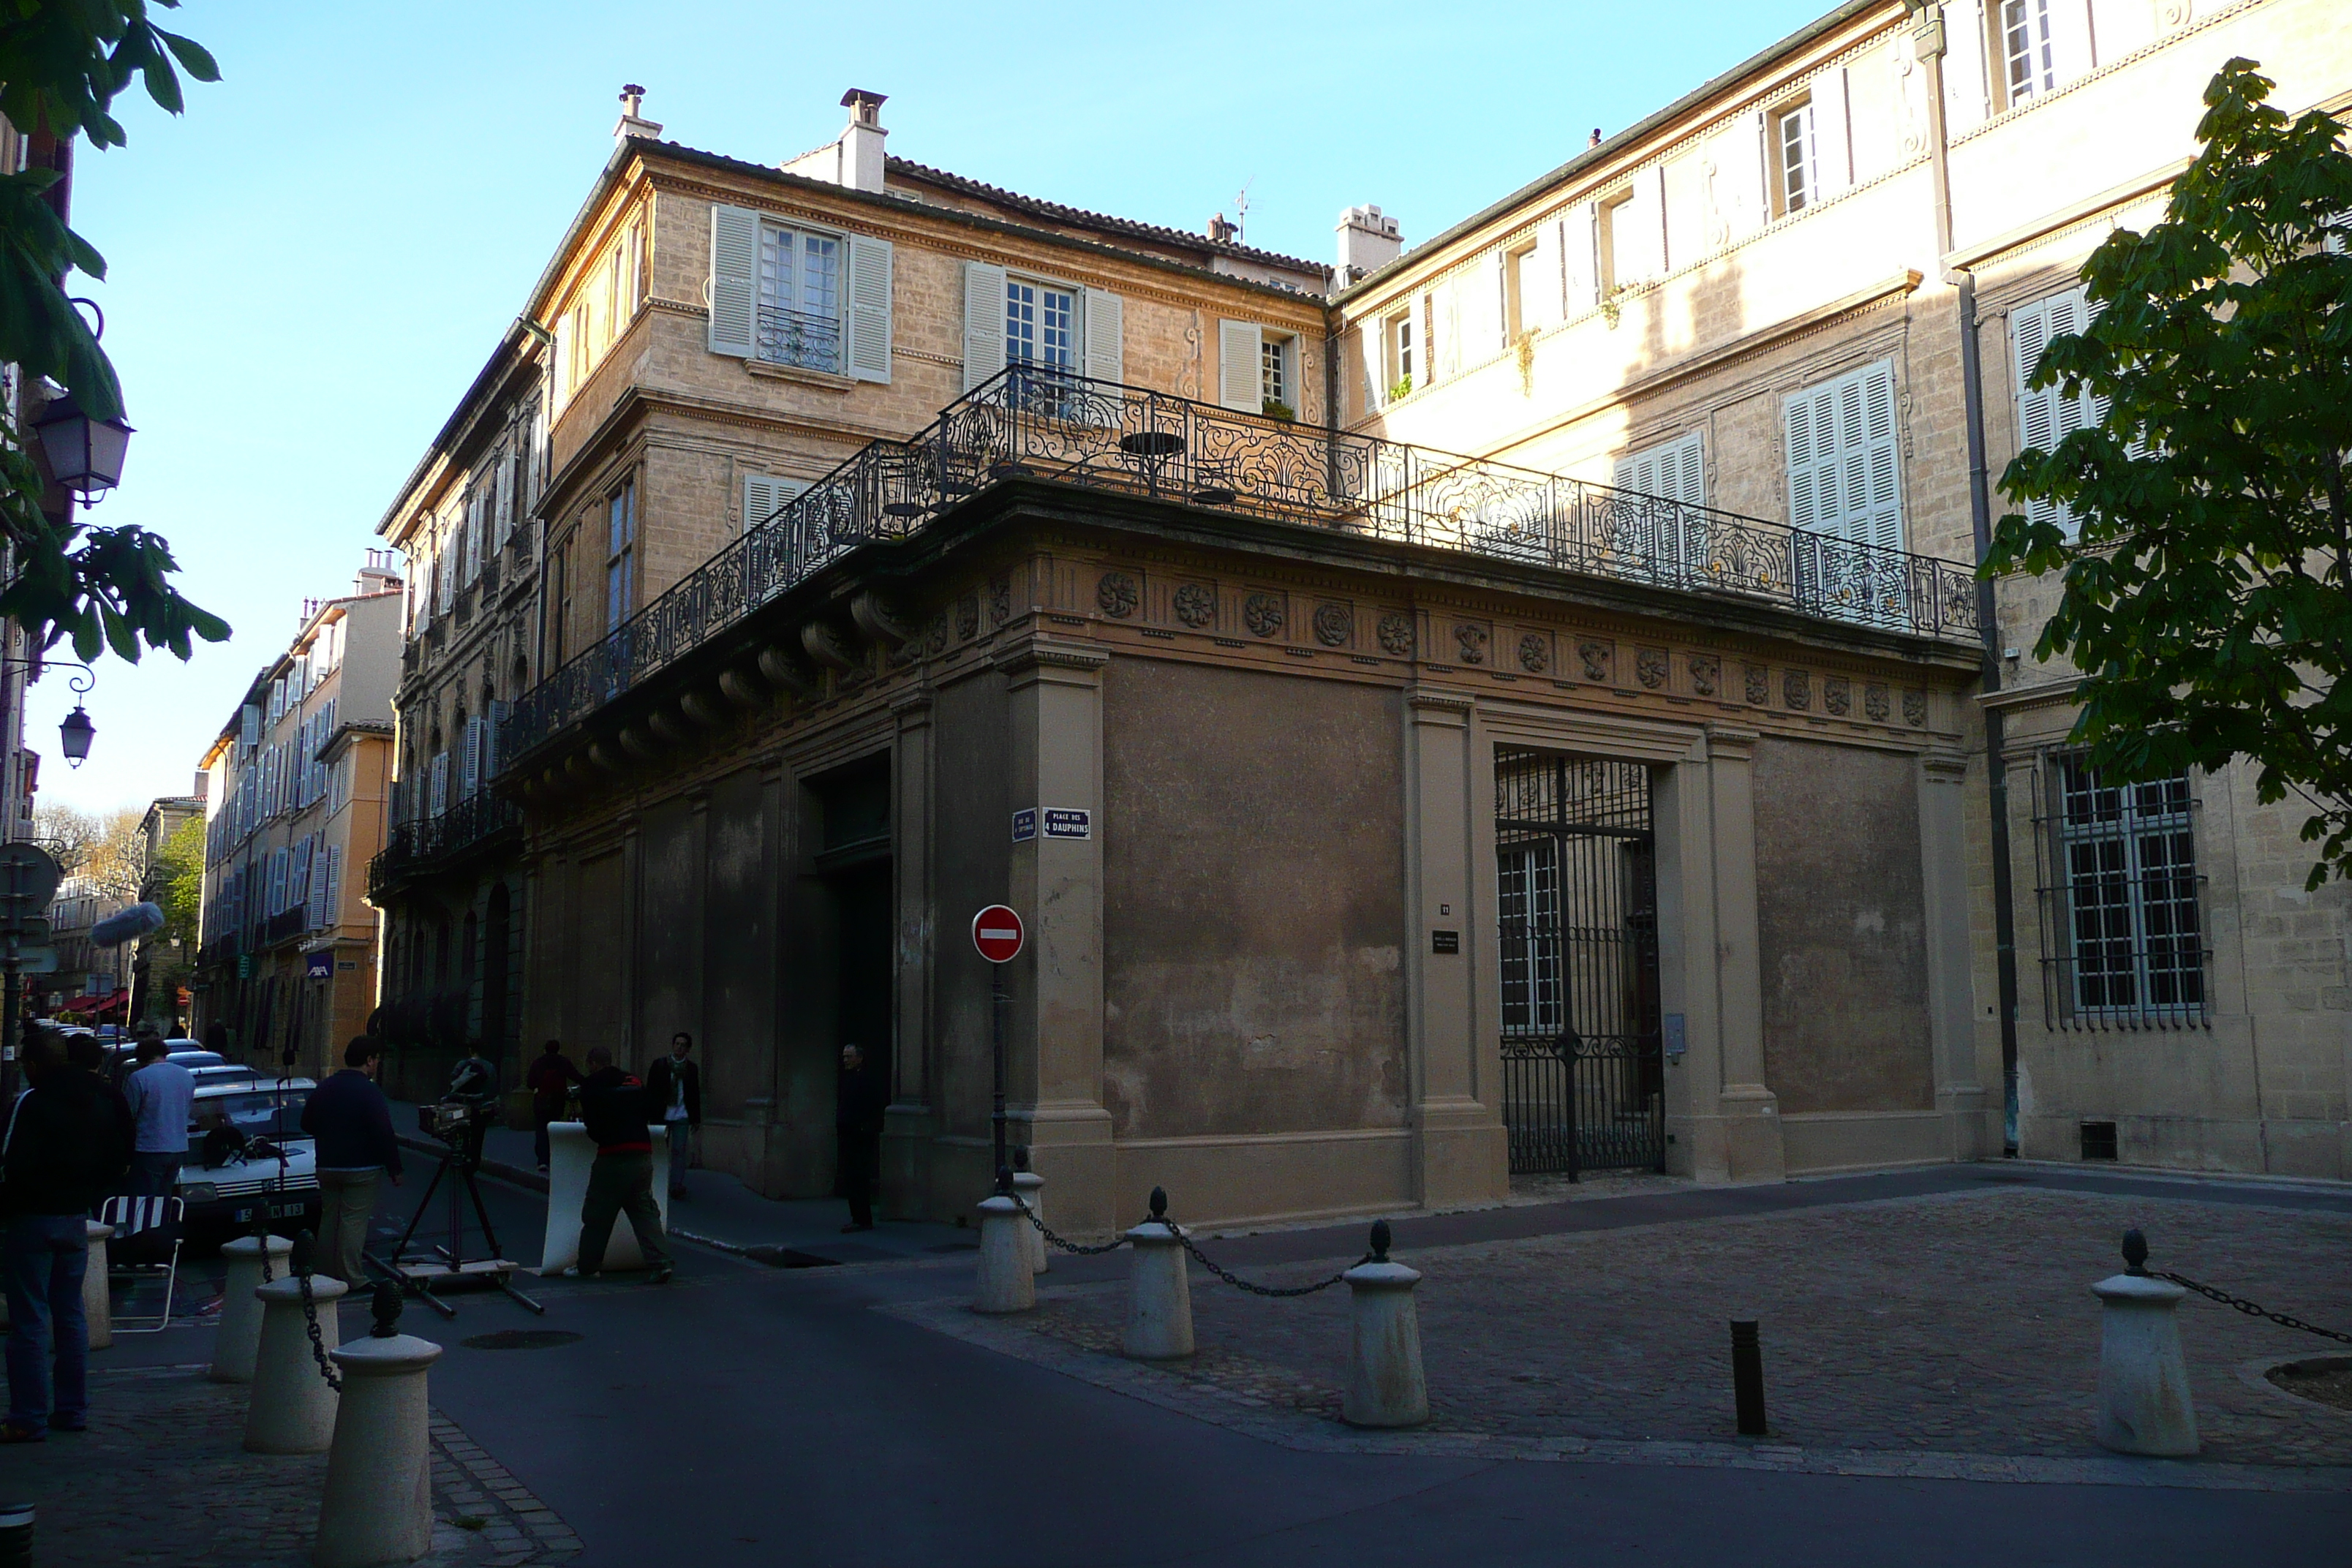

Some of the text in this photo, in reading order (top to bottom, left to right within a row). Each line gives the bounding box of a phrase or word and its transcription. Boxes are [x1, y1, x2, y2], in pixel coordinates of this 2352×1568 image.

[1053, 813, 1068, 821] PLACE
[1045, 821, 1049, 831] 4
[1053, 822, 1088, 833] DAUPHINS
[308, 965, 328, 976] AXA
